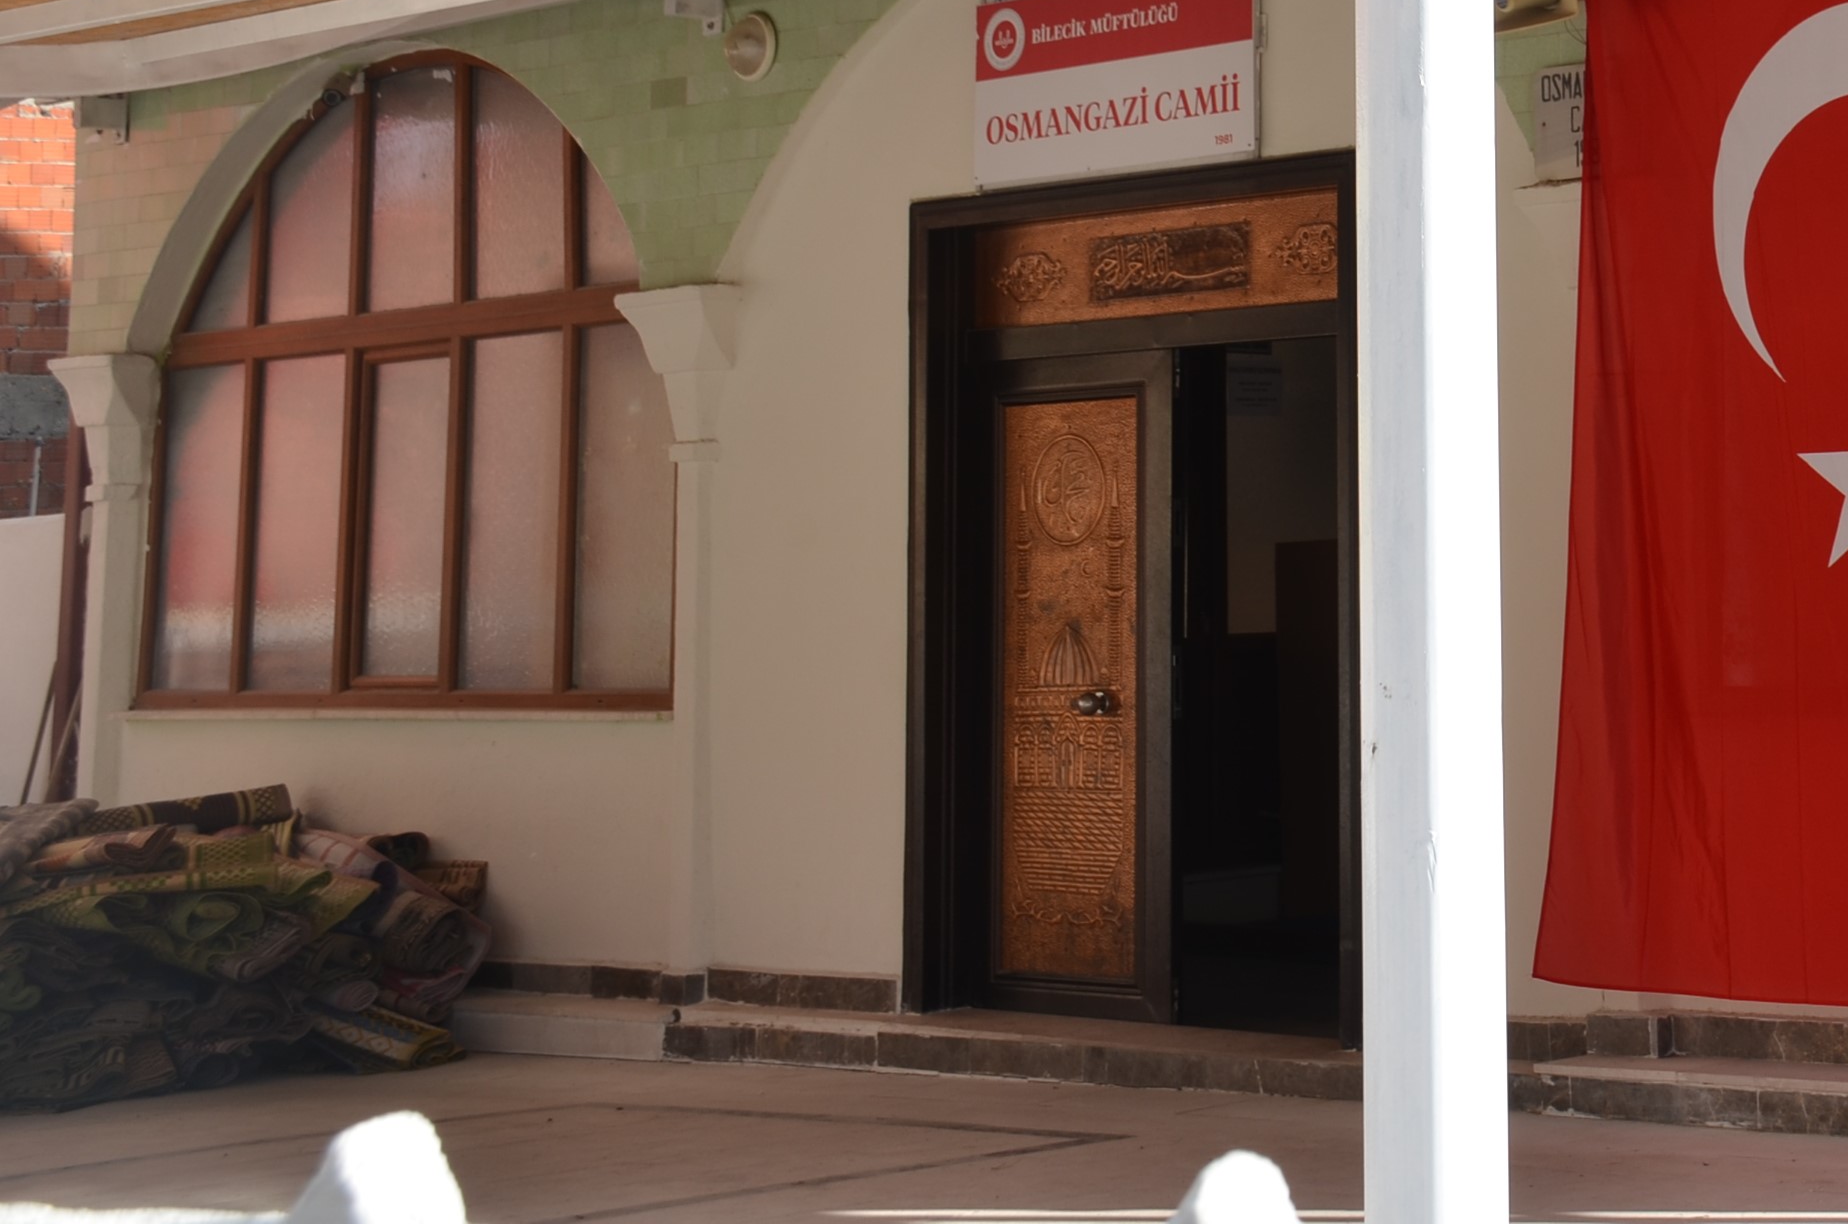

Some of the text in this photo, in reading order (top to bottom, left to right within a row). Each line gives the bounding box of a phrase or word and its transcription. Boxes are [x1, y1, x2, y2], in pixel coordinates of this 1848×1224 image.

[1031, 2, 1179, 45] BİLECİK MÜFTÜLÜĞÜ
[1541, 70, 1585, 103] OSMA
[985, 72, 1241, 145] OSMANGAZİ CAMİİ
